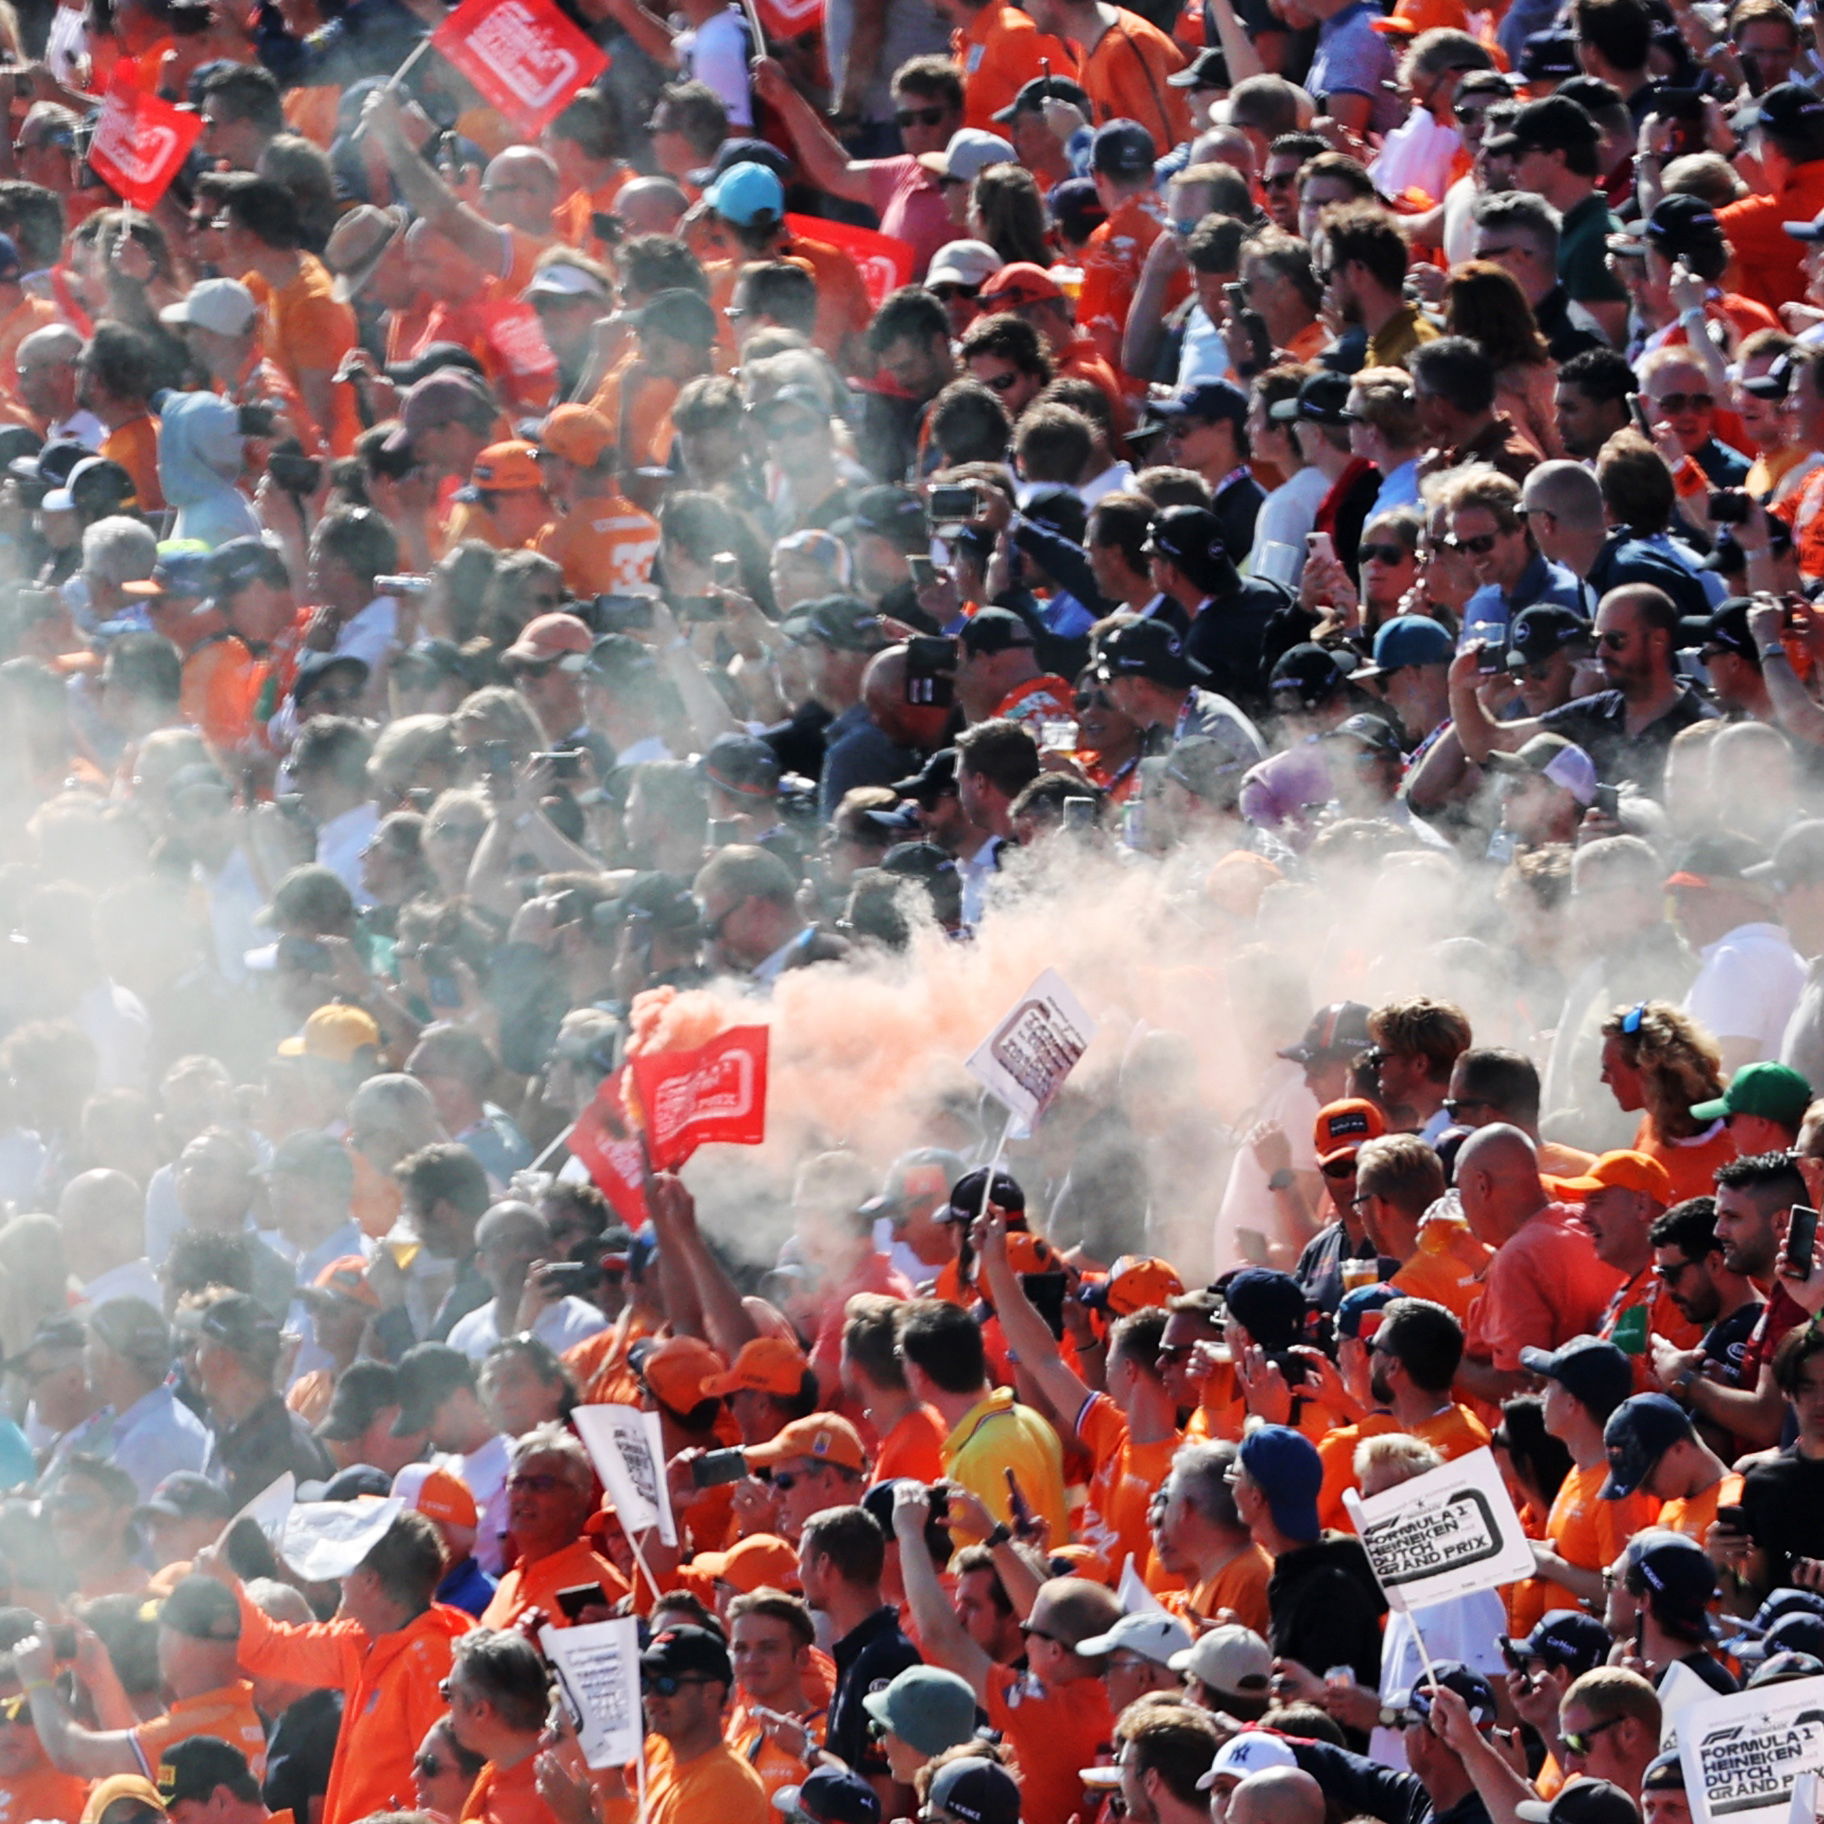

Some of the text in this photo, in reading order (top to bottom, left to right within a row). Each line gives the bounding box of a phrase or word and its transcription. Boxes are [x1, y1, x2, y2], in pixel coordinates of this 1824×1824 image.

[1364, 1504, 1467, 1546] FORMULA 1
[1369, 1520, 1458, 1558] HEINEKEN
[1373, 1542, 1434, 1566] DUTCH
[1377, 1535, 1489, 1575] GRAND PRIX
[1701, 1727, 1814, 1760] FORMULA 1
[1704, 1744, 1801, 1773] HEINEKEN
[1705, 1766, 1772, 1787] DUTCH
[1708, 1777, 1778, 1800] GRAND
